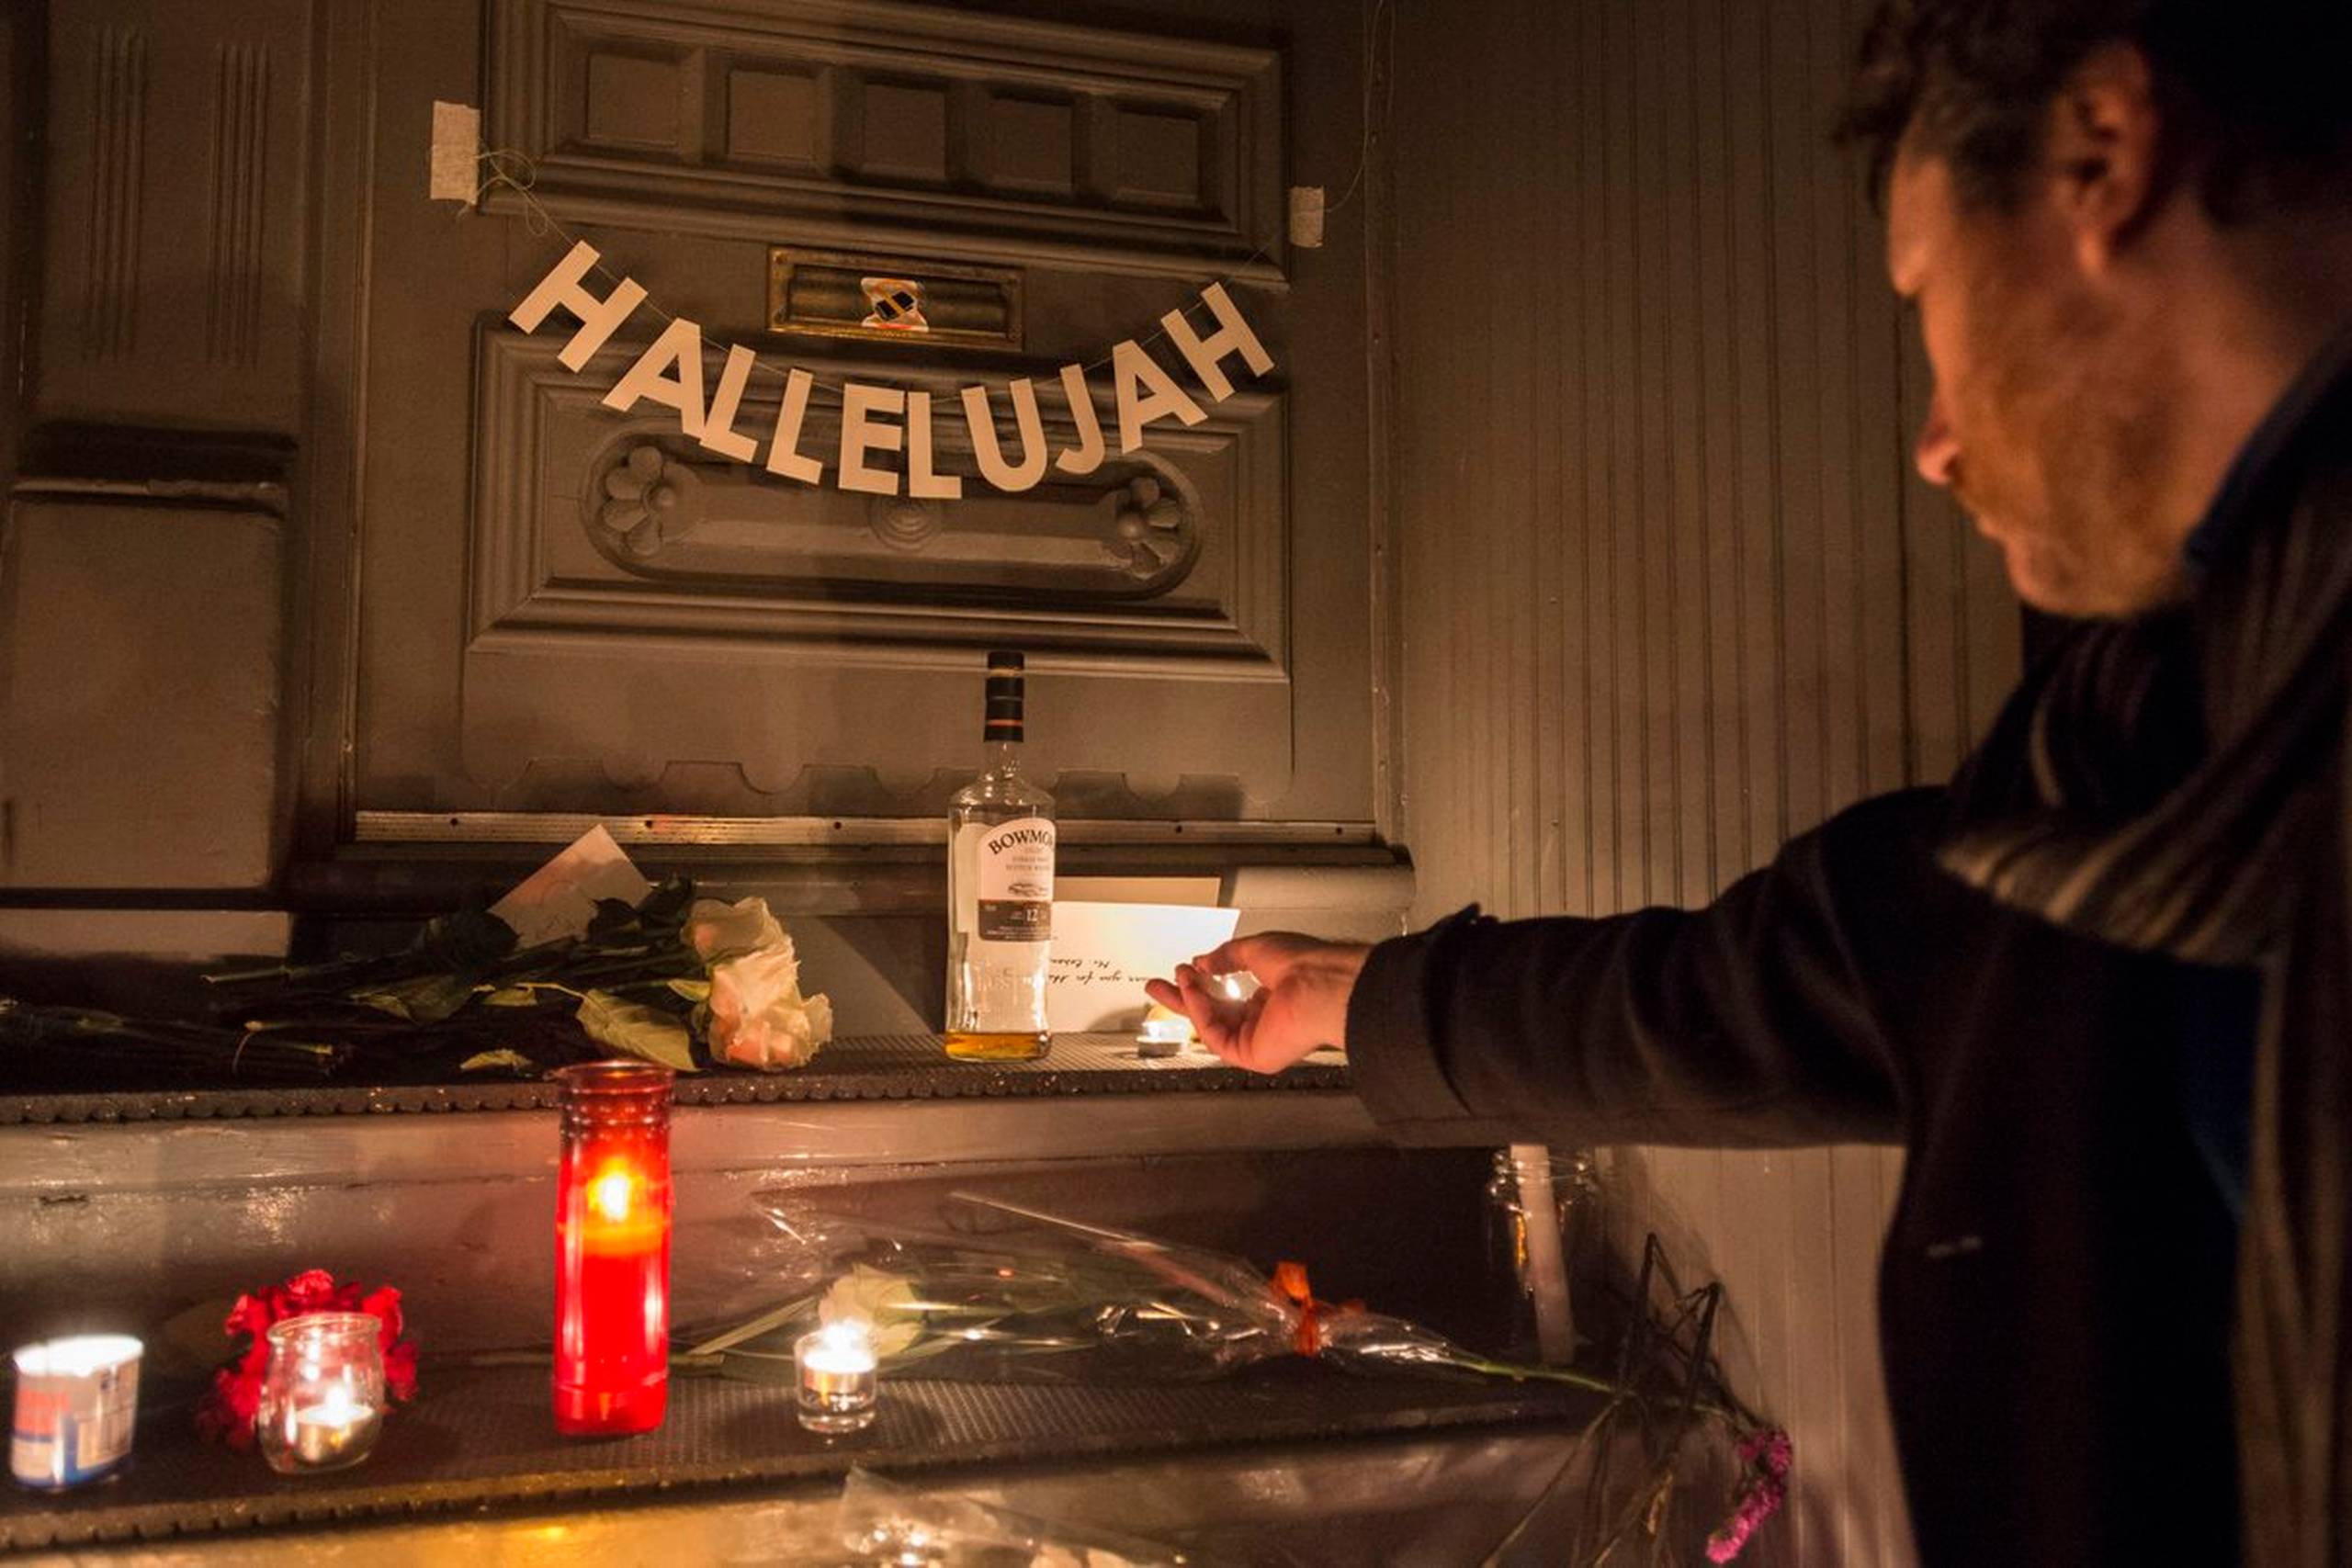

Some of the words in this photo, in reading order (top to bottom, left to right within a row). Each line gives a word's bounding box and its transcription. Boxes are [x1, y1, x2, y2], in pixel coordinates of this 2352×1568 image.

[509, 240, 1275, 500] HALLELUJAH
[988, 829, 1054, 855] BOWMO
[1026, 908, 1038, 922] 12
